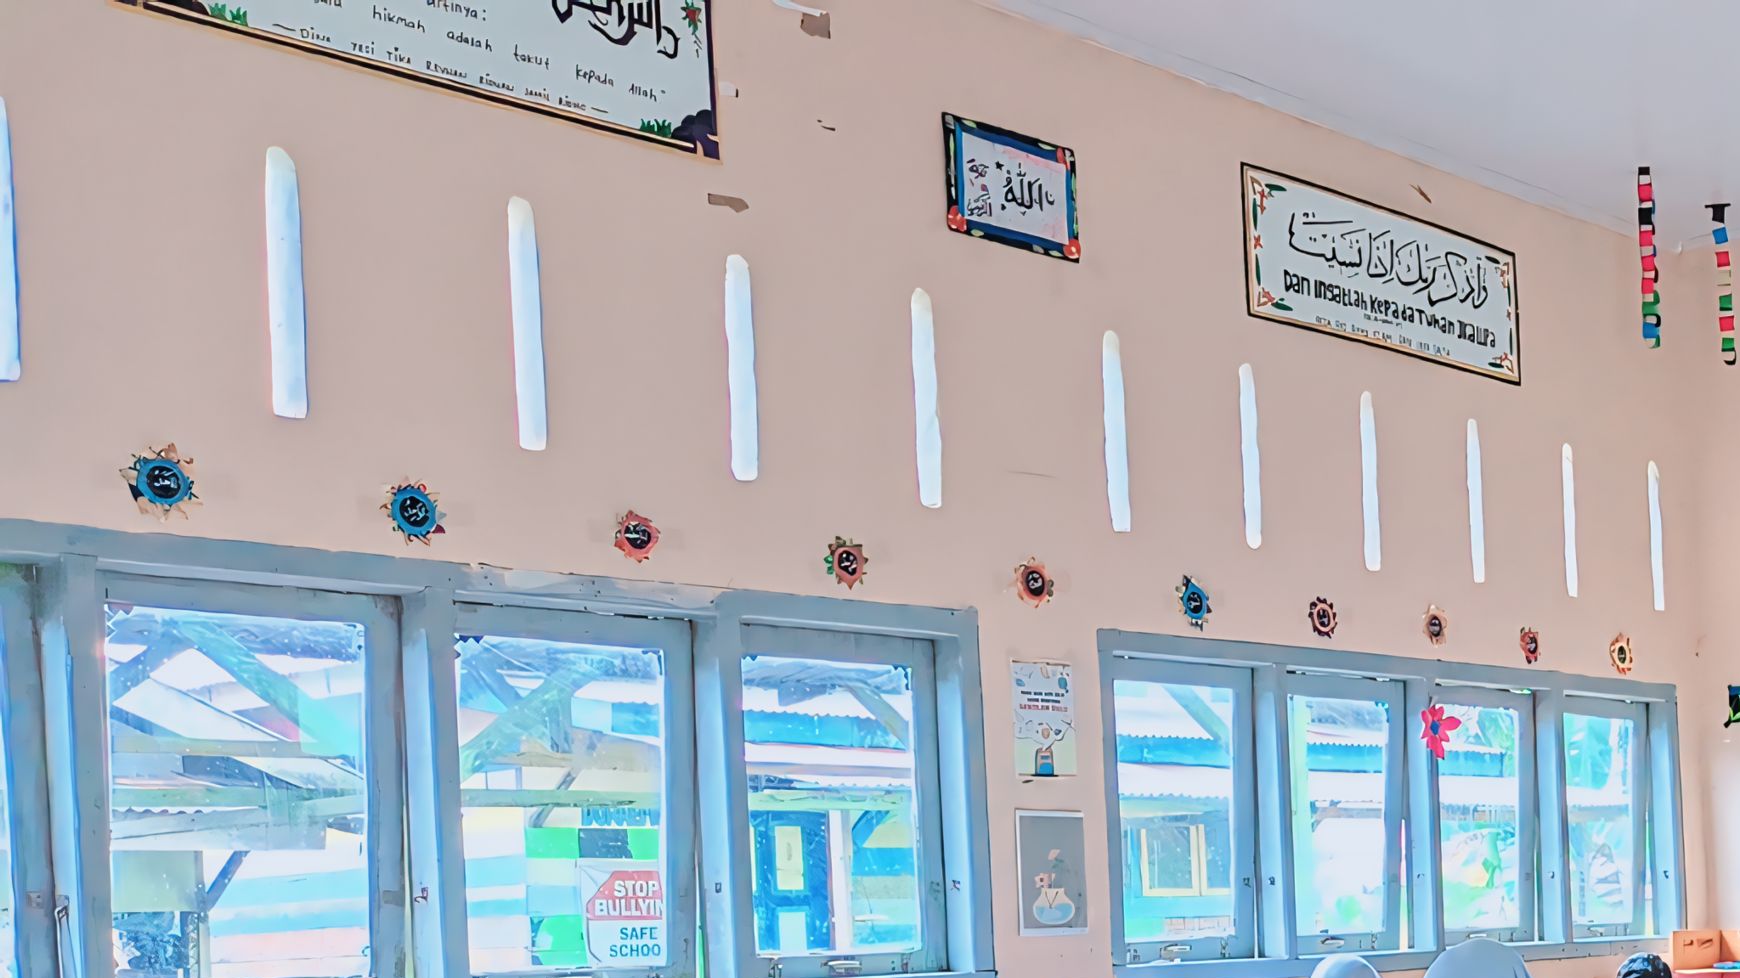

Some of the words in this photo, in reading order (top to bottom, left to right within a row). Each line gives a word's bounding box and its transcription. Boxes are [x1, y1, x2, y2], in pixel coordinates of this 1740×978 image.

[372, 4, 426, 33] hikmah
[447, 30, 493, 52] adalah
[513, 43, 551, 70] takut
[1283, 268, 1311, 296] Dan
[614, 880, 660, 898] STOP
[619, 926, 659, 941] SAFE
